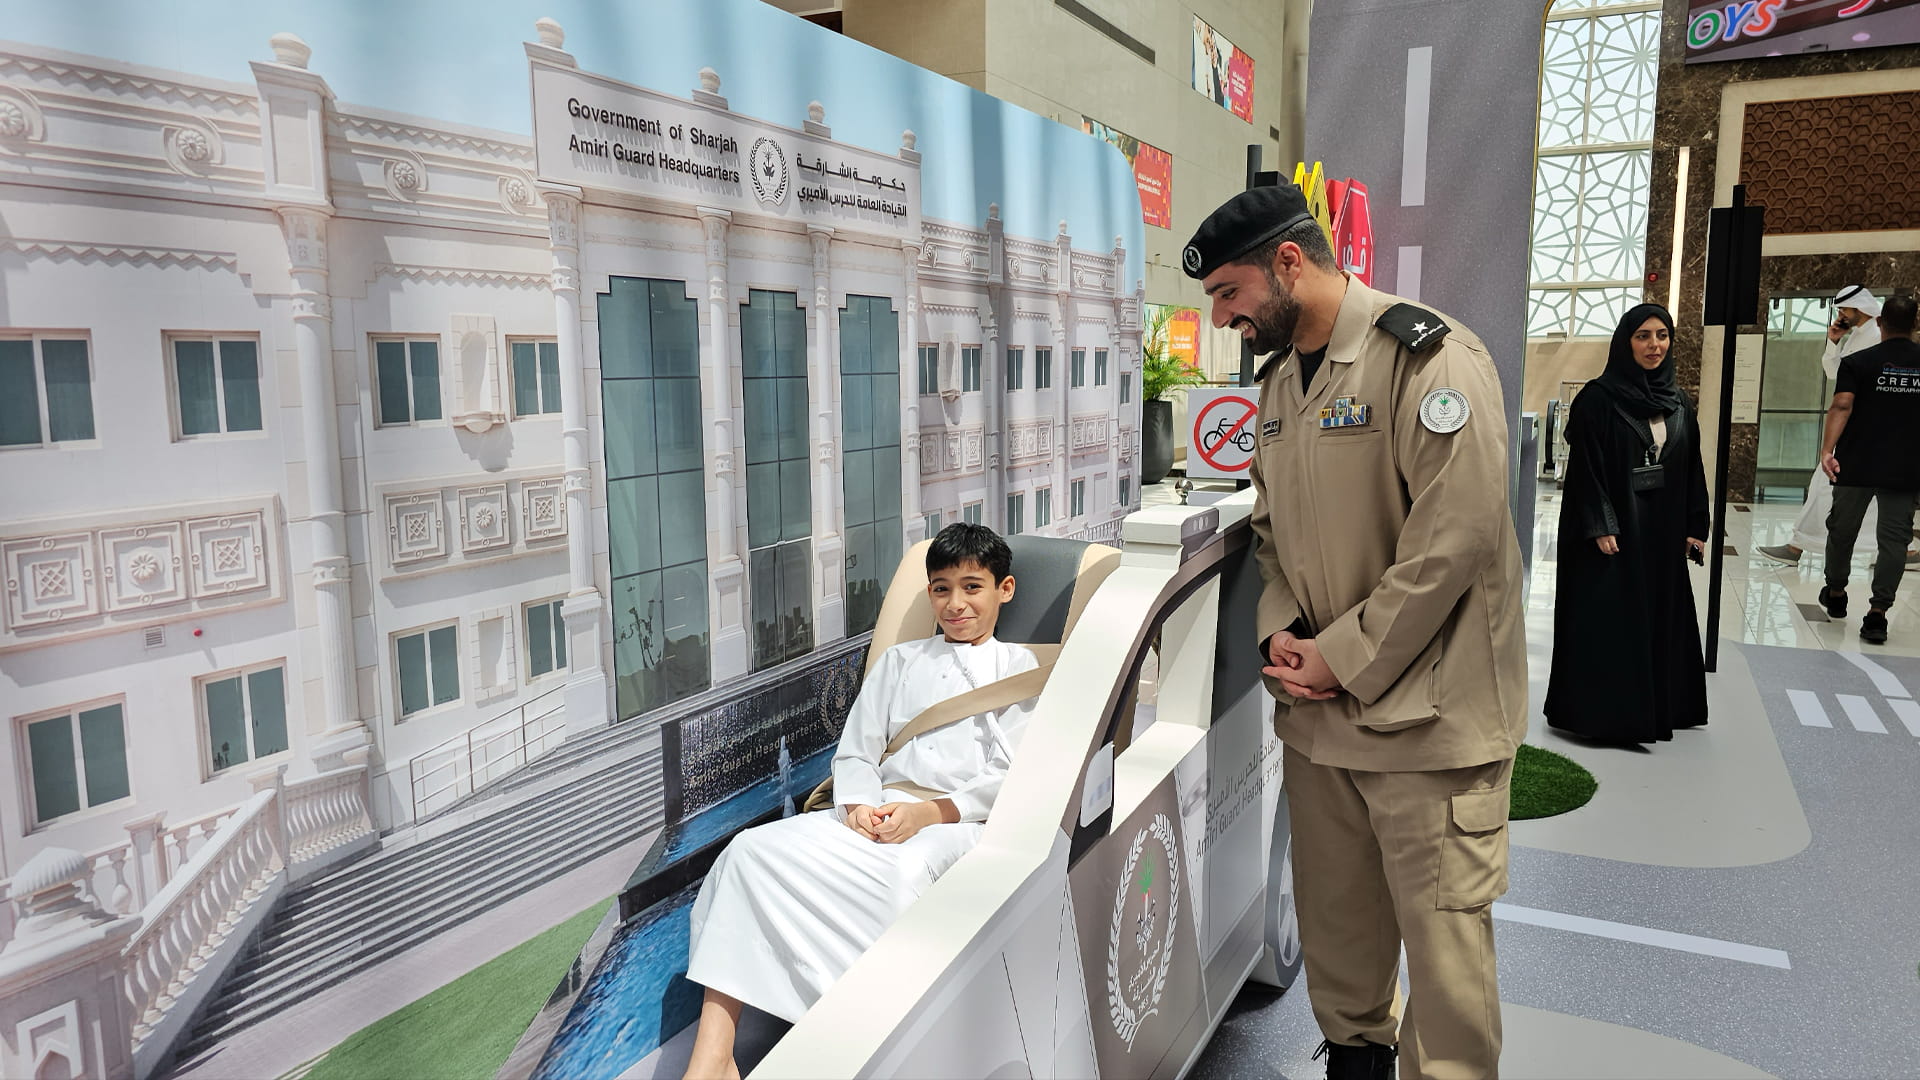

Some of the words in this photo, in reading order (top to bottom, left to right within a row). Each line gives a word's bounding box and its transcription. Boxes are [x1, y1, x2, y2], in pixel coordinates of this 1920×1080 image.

[1687, 0, 1786, 49] OYS
[567, 97, 662, 136] Government
[669, 124, 683, 141] of
[690, 127, 738, 155] Sharjah
[569, 134, 609, 158] Amiri
[613, 143, 655, 167] Guard
[659, 152, 740, 183] Headquarters
[796, 153, 852, 180] الشارقة
[852, 167, 906, 192] حكومة
[797, 185, 829, 202] الأميري
[829, 194, 856, 208] للحرس
[857, 195, 881, 212] العامة
[881, 200, 907, 218] القيادة
[1877, 376, 1920, 386] CREW
[756, 720, 820, 757] Headuarters
[1220, 801, 1241, 835] Guard
